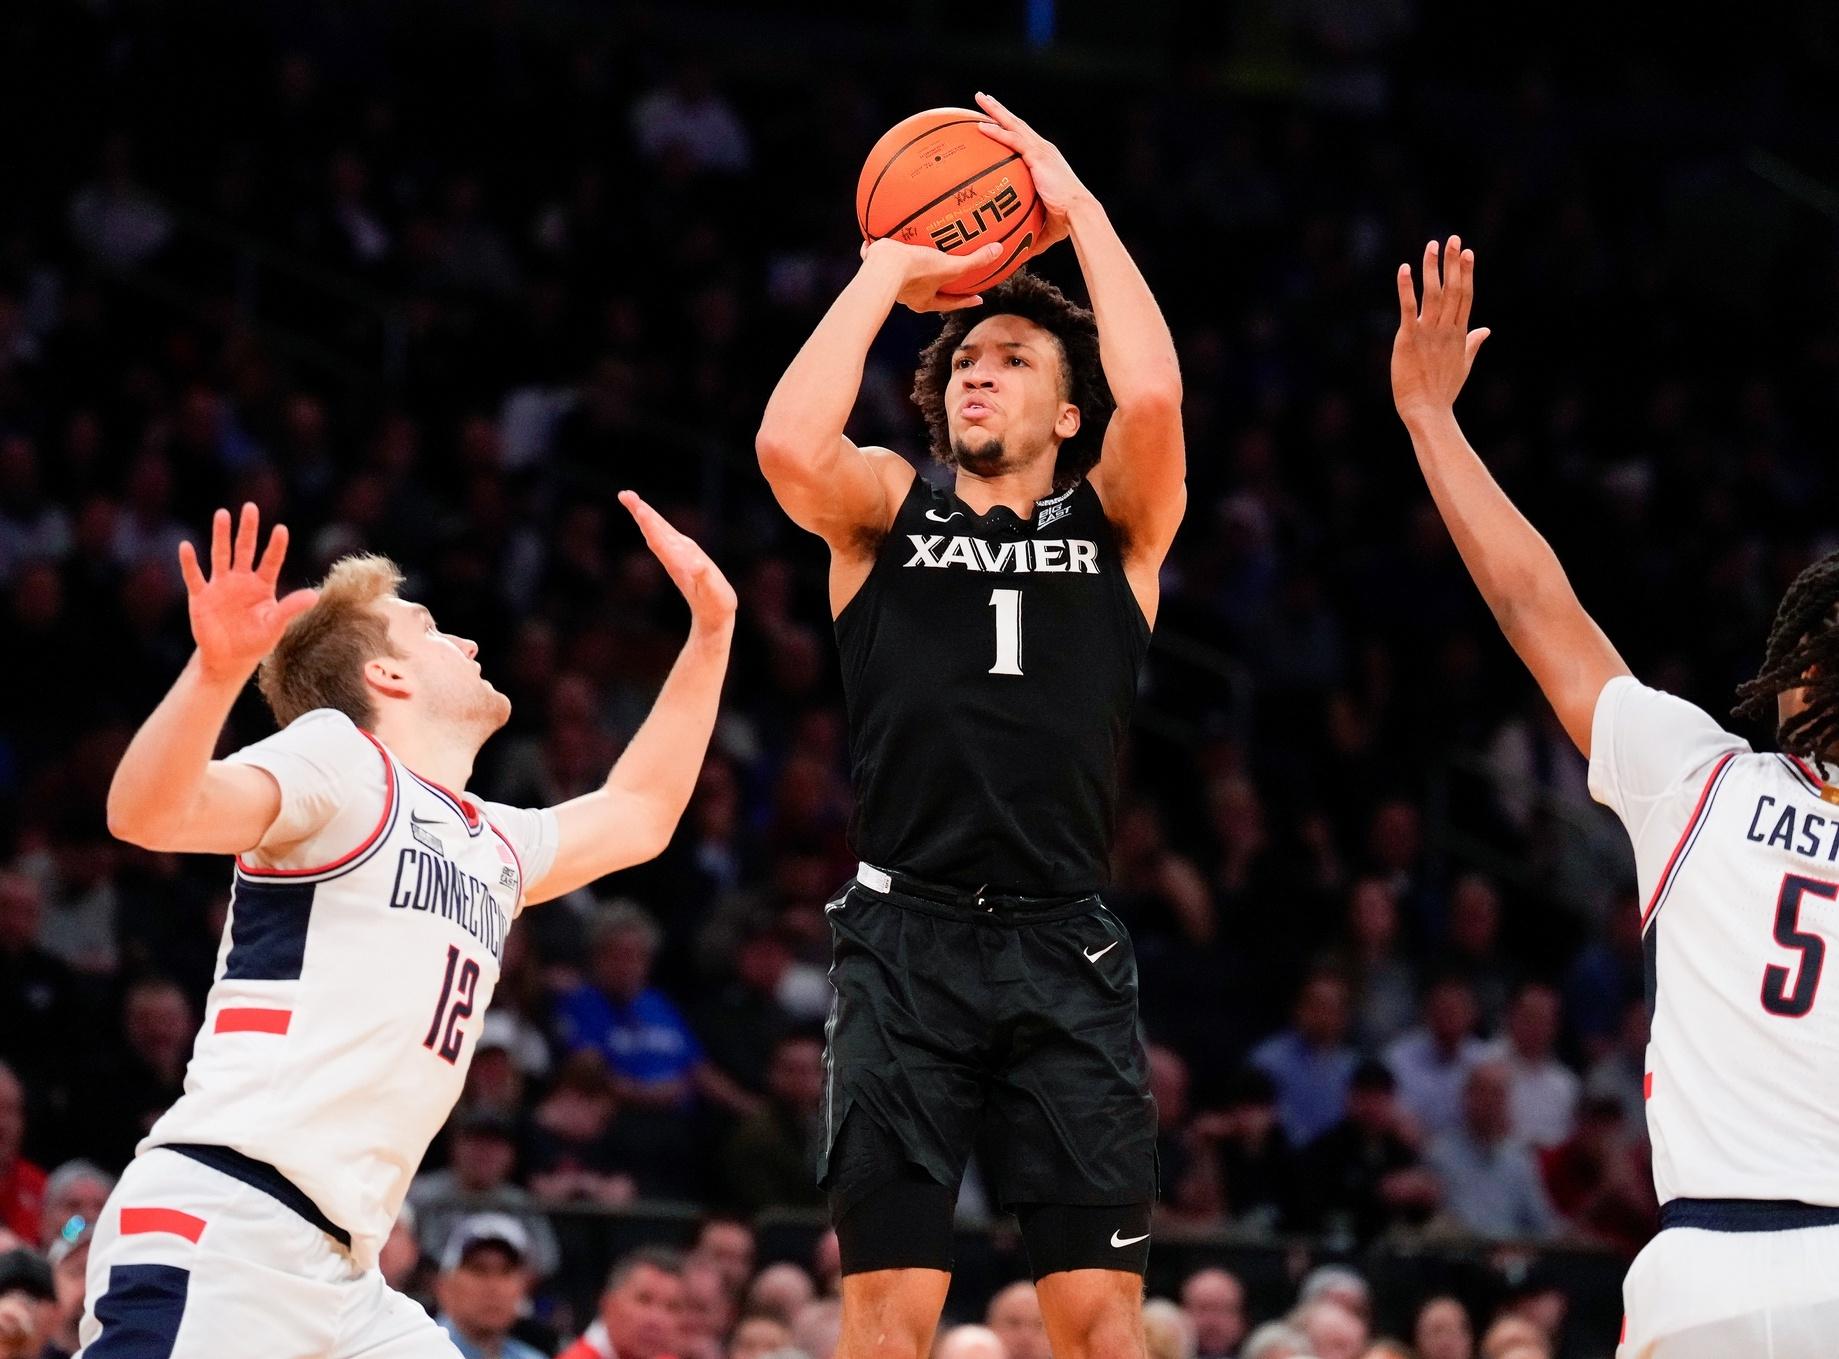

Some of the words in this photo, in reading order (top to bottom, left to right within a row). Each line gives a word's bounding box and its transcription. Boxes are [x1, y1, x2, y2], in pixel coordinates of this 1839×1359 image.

[929, 185, 1022, 252] ELITE
[1037, 505, 1072, 527] EAST
[1038, 502, 1063, 519] BIG
[902, 533, 1101, 575] XAVIER
[988, 588, 1025, 676] 1
[1760, 872, 1839, 1019] 5
[422, 943, 480, 1067] 12
